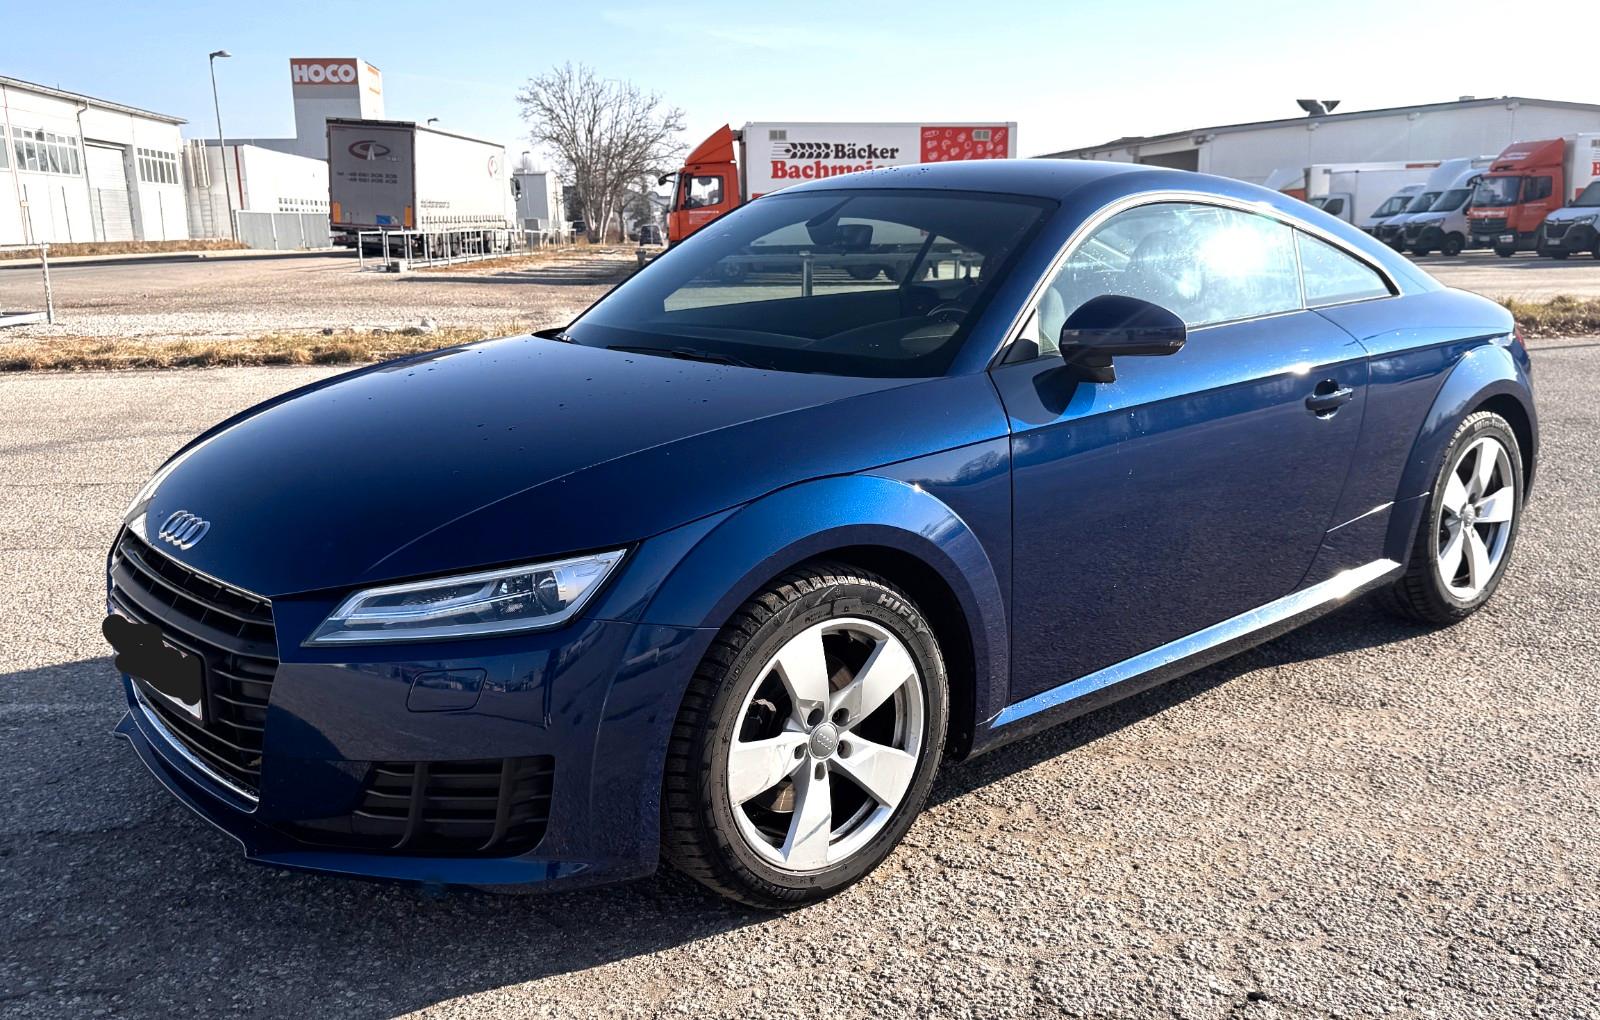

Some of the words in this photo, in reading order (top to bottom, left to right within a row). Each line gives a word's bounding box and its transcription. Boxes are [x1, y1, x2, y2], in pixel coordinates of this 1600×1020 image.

[292, 63, 356, 83] HOCO
[833, 143, 899, 160] Bäcker
[877, 593, 930, 633] HIFLY
